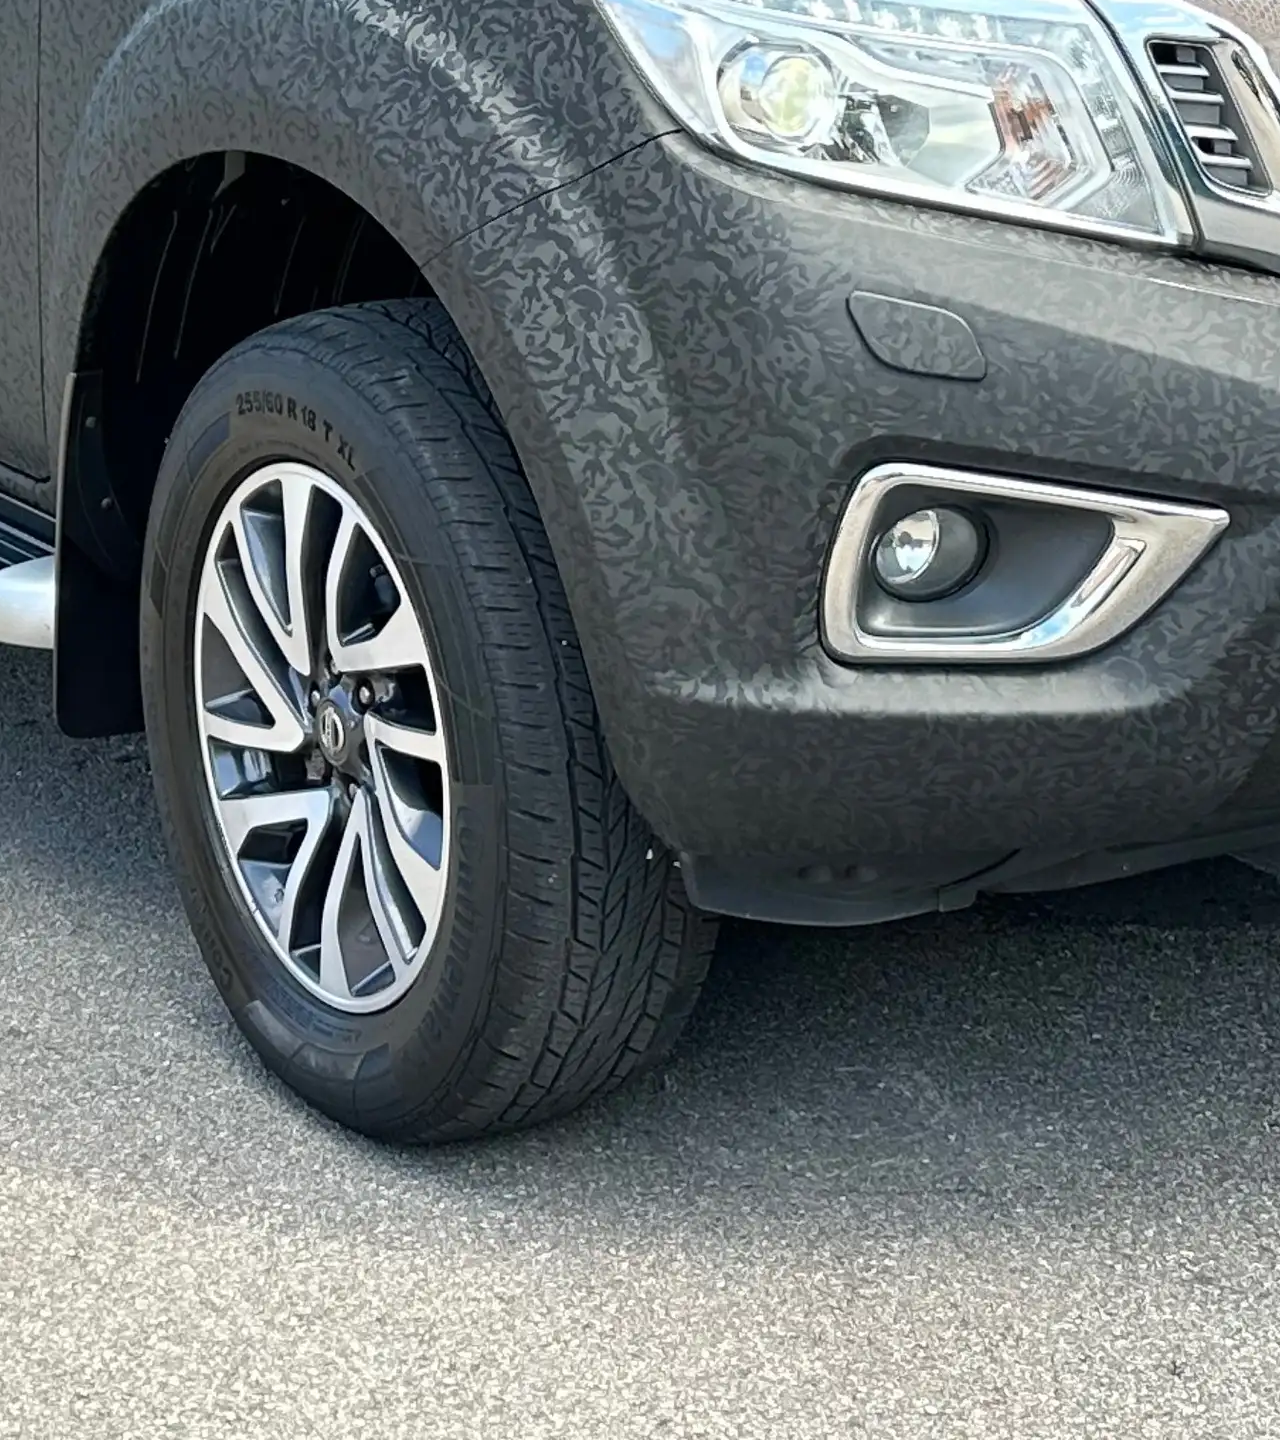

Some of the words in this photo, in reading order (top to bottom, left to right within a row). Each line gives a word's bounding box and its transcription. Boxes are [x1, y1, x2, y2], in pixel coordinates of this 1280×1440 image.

[236, 389, 283, 416] 255/60
[286, 397, 298, 421] R
[301, 405, 317, 432] 18
[322, 419, 334, 443] T
